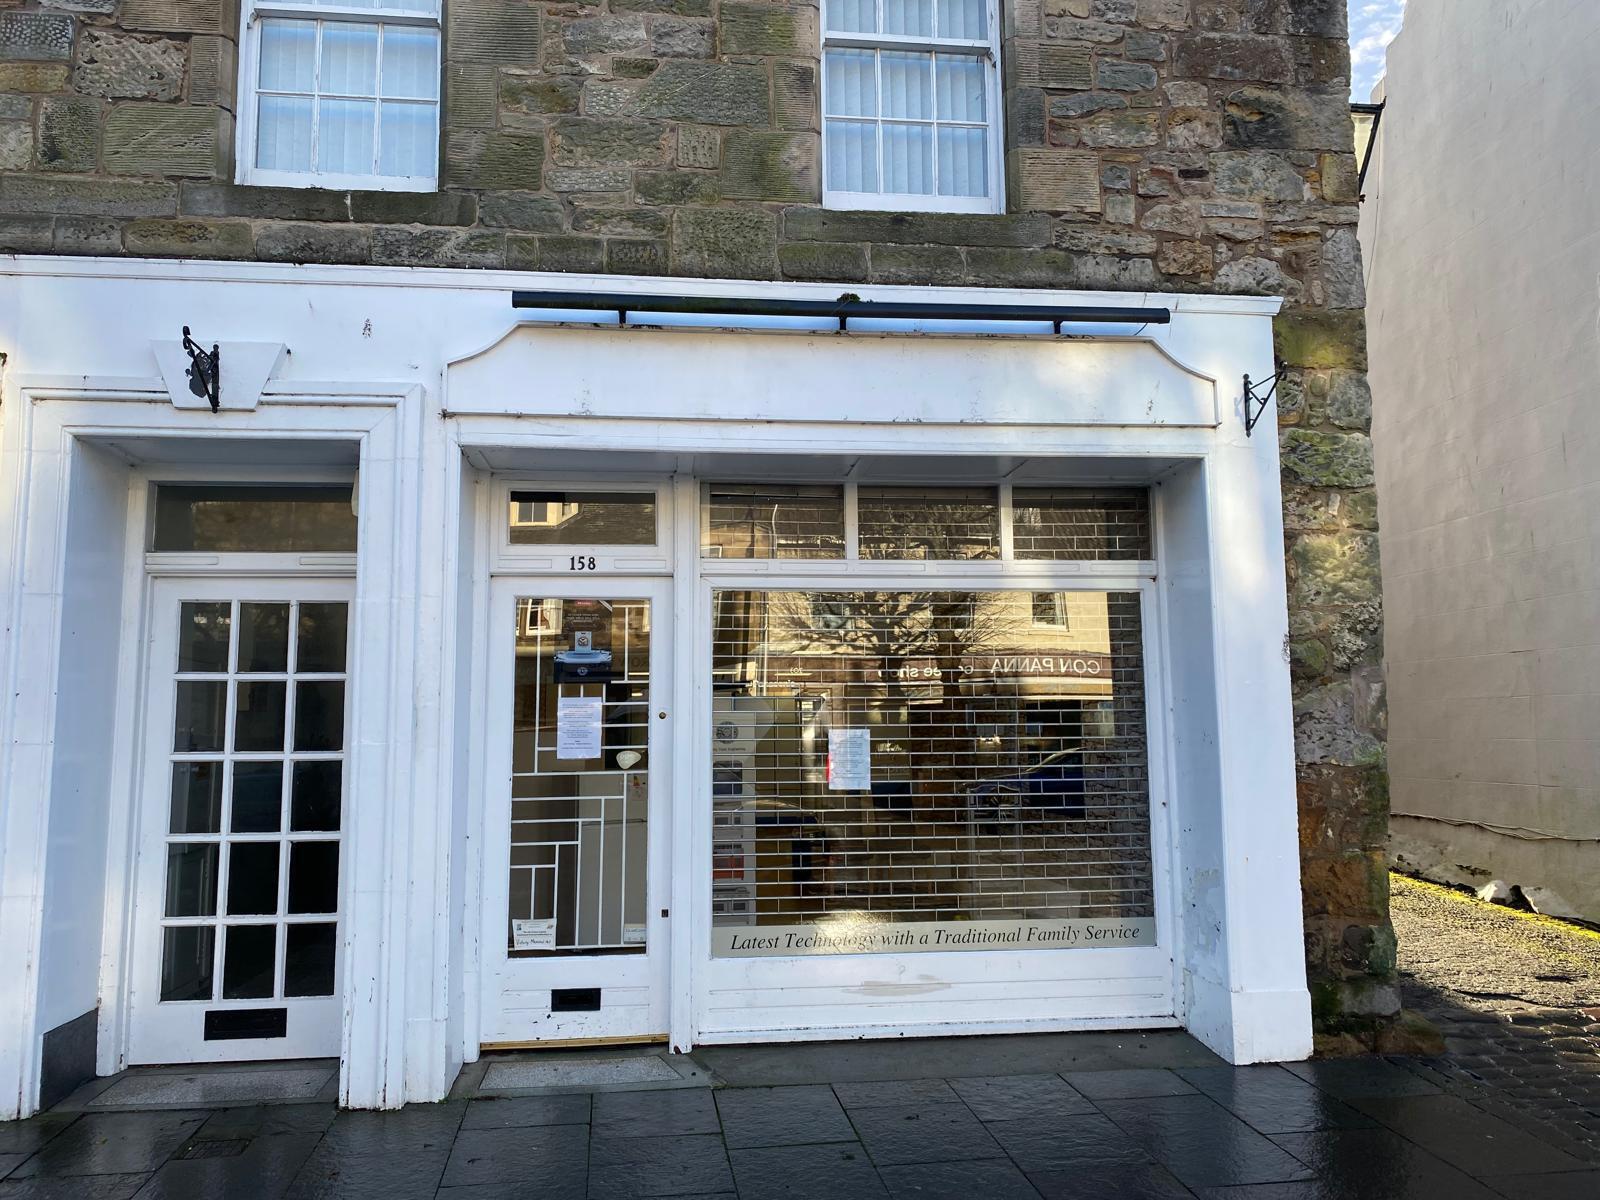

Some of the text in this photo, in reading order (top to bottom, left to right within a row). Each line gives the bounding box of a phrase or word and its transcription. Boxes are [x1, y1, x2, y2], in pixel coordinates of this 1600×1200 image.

[570, 555, 596, 571] 158
[731, 924, 1140, 951] Latest Technology with a Traditional Family Service
